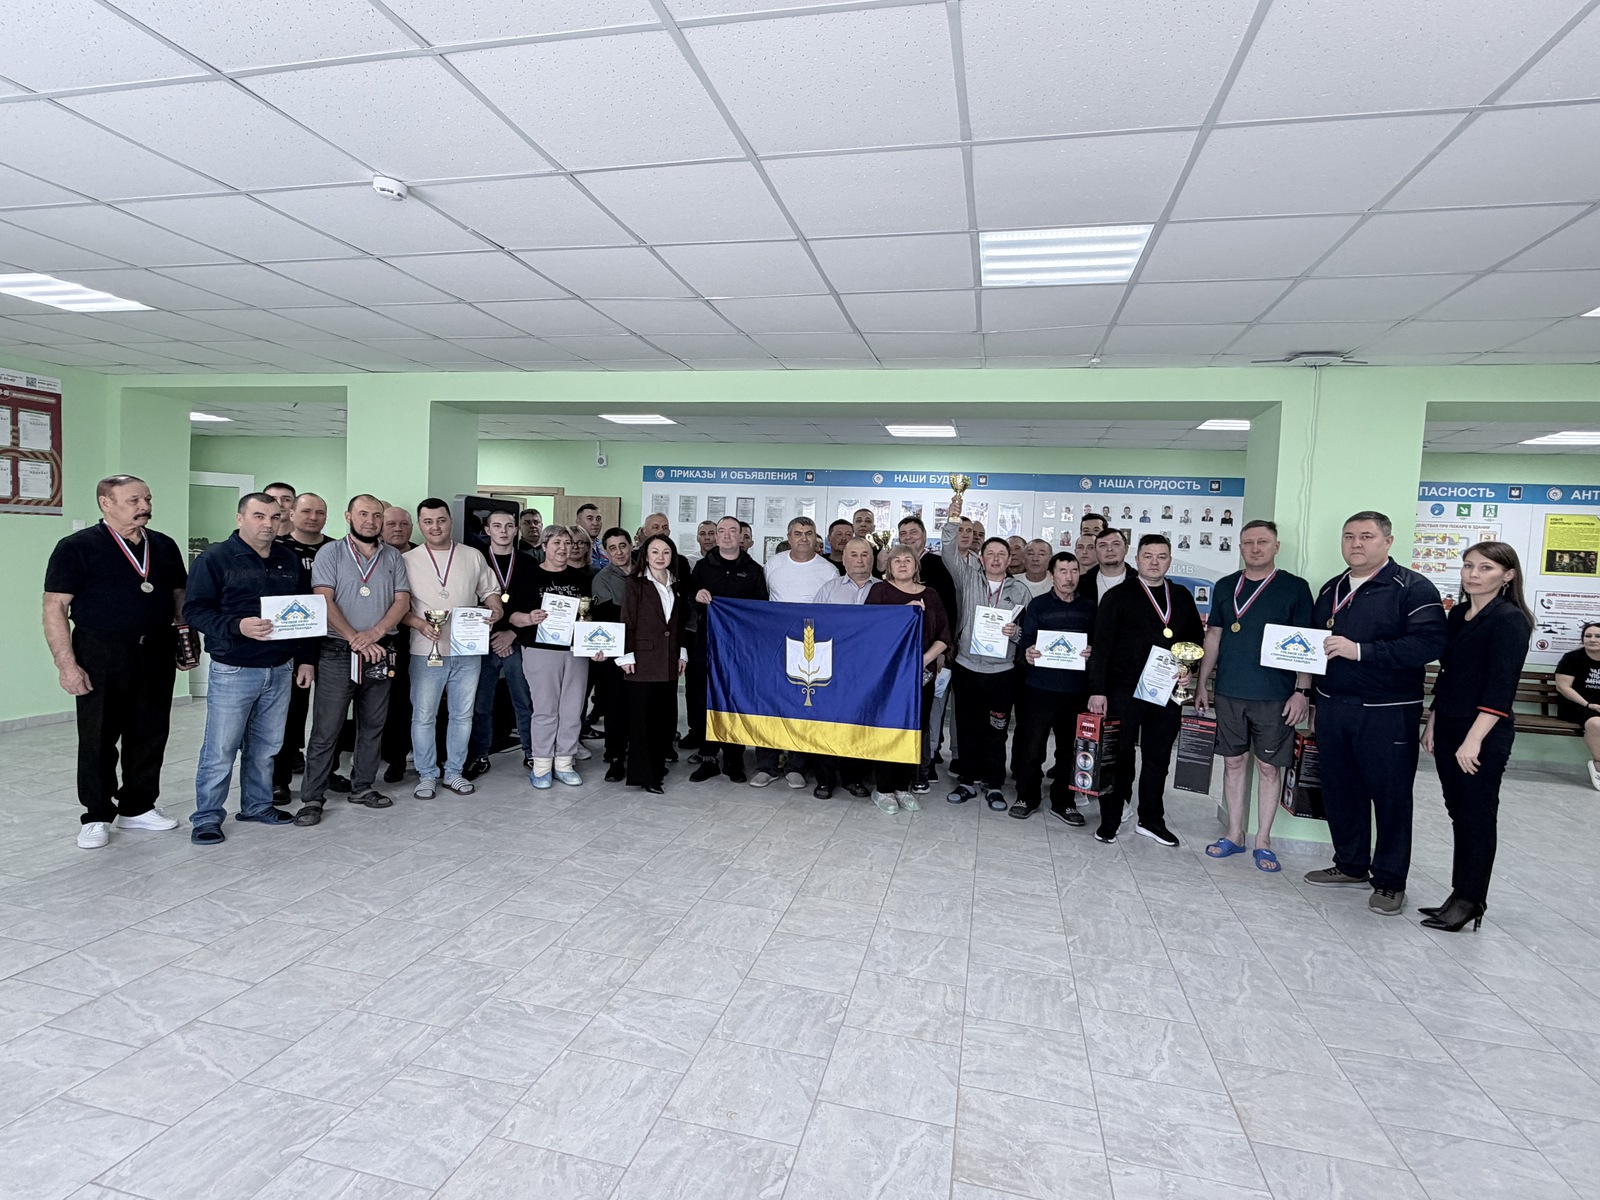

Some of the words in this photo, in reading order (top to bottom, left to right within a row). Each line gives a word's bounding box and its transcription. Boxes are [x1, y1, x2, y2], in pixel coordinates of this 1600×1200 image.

[670, 470, 716, 479] ПРИКАЗЫ
[720, 471, 728, 479] И
[730, 471, 798, 480] ОБЪЯВЛЕНИЯ
[894, 474, 926, 483] НАШИ
[929, 474, 950, 485] БУД
[1098, 478, 1134, 488] НАША
[1138, 480, 1201, 490] ГОРДОСТЬ
[1419, 486, 1496, 498] ПАСНОСТЬ
[1570, 490, 1600, 500] АНТ
[1171, 564, 1194, 574] ТИВ
